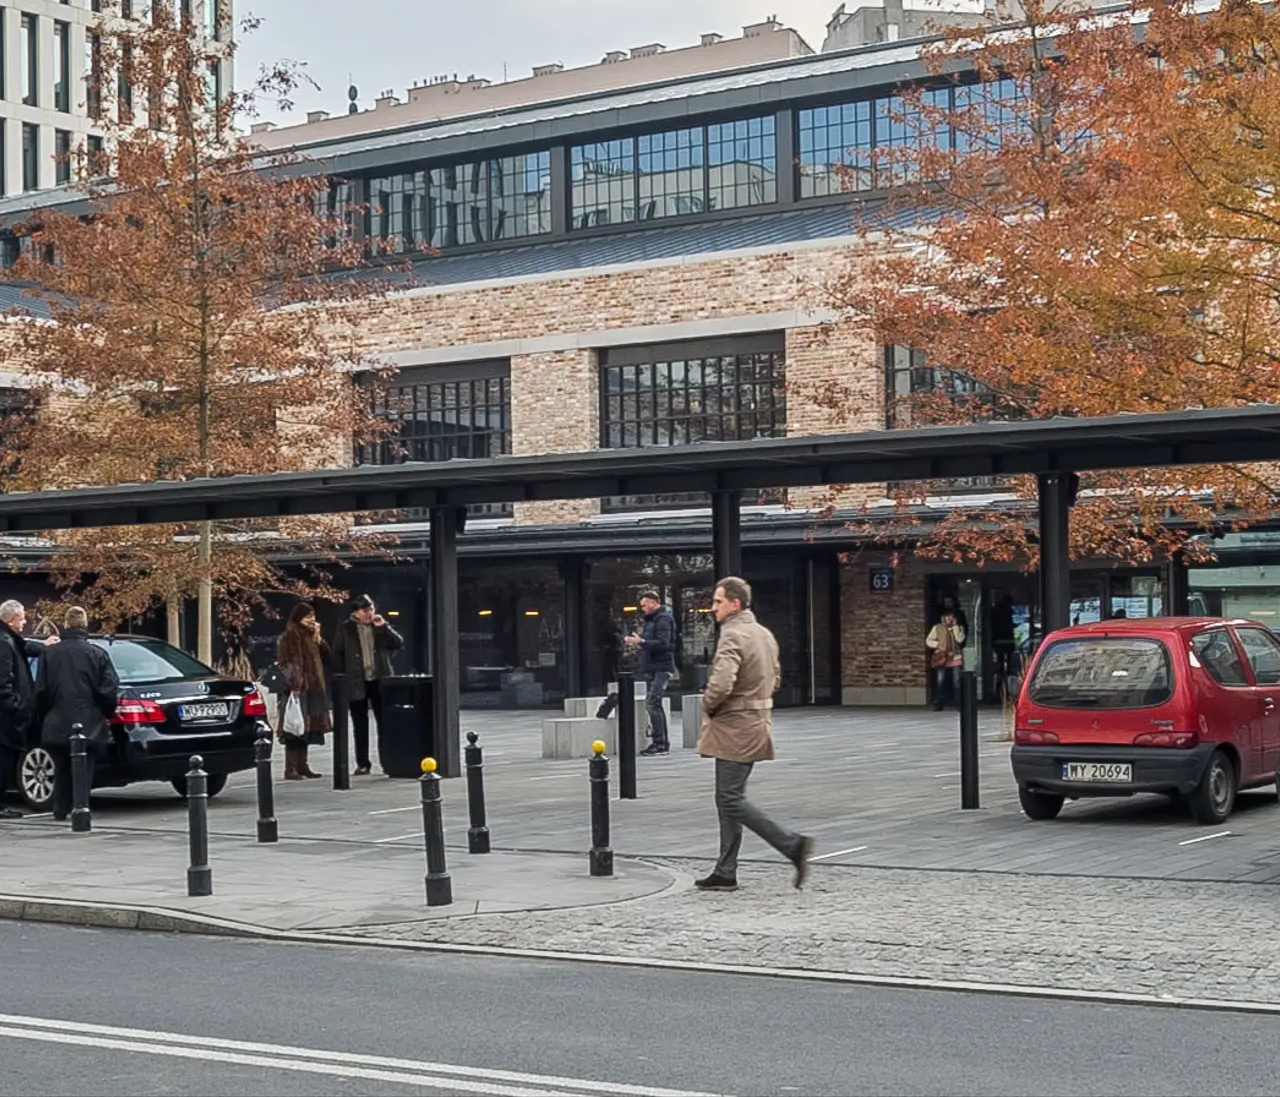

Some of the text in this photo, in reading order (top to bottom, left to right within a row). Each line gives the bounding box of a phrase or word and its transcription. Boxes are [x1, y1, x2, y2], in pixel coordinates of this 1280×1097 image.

[873, 574, 889, 589] 63
[1070, 764, 1130, 779] WY 20694
